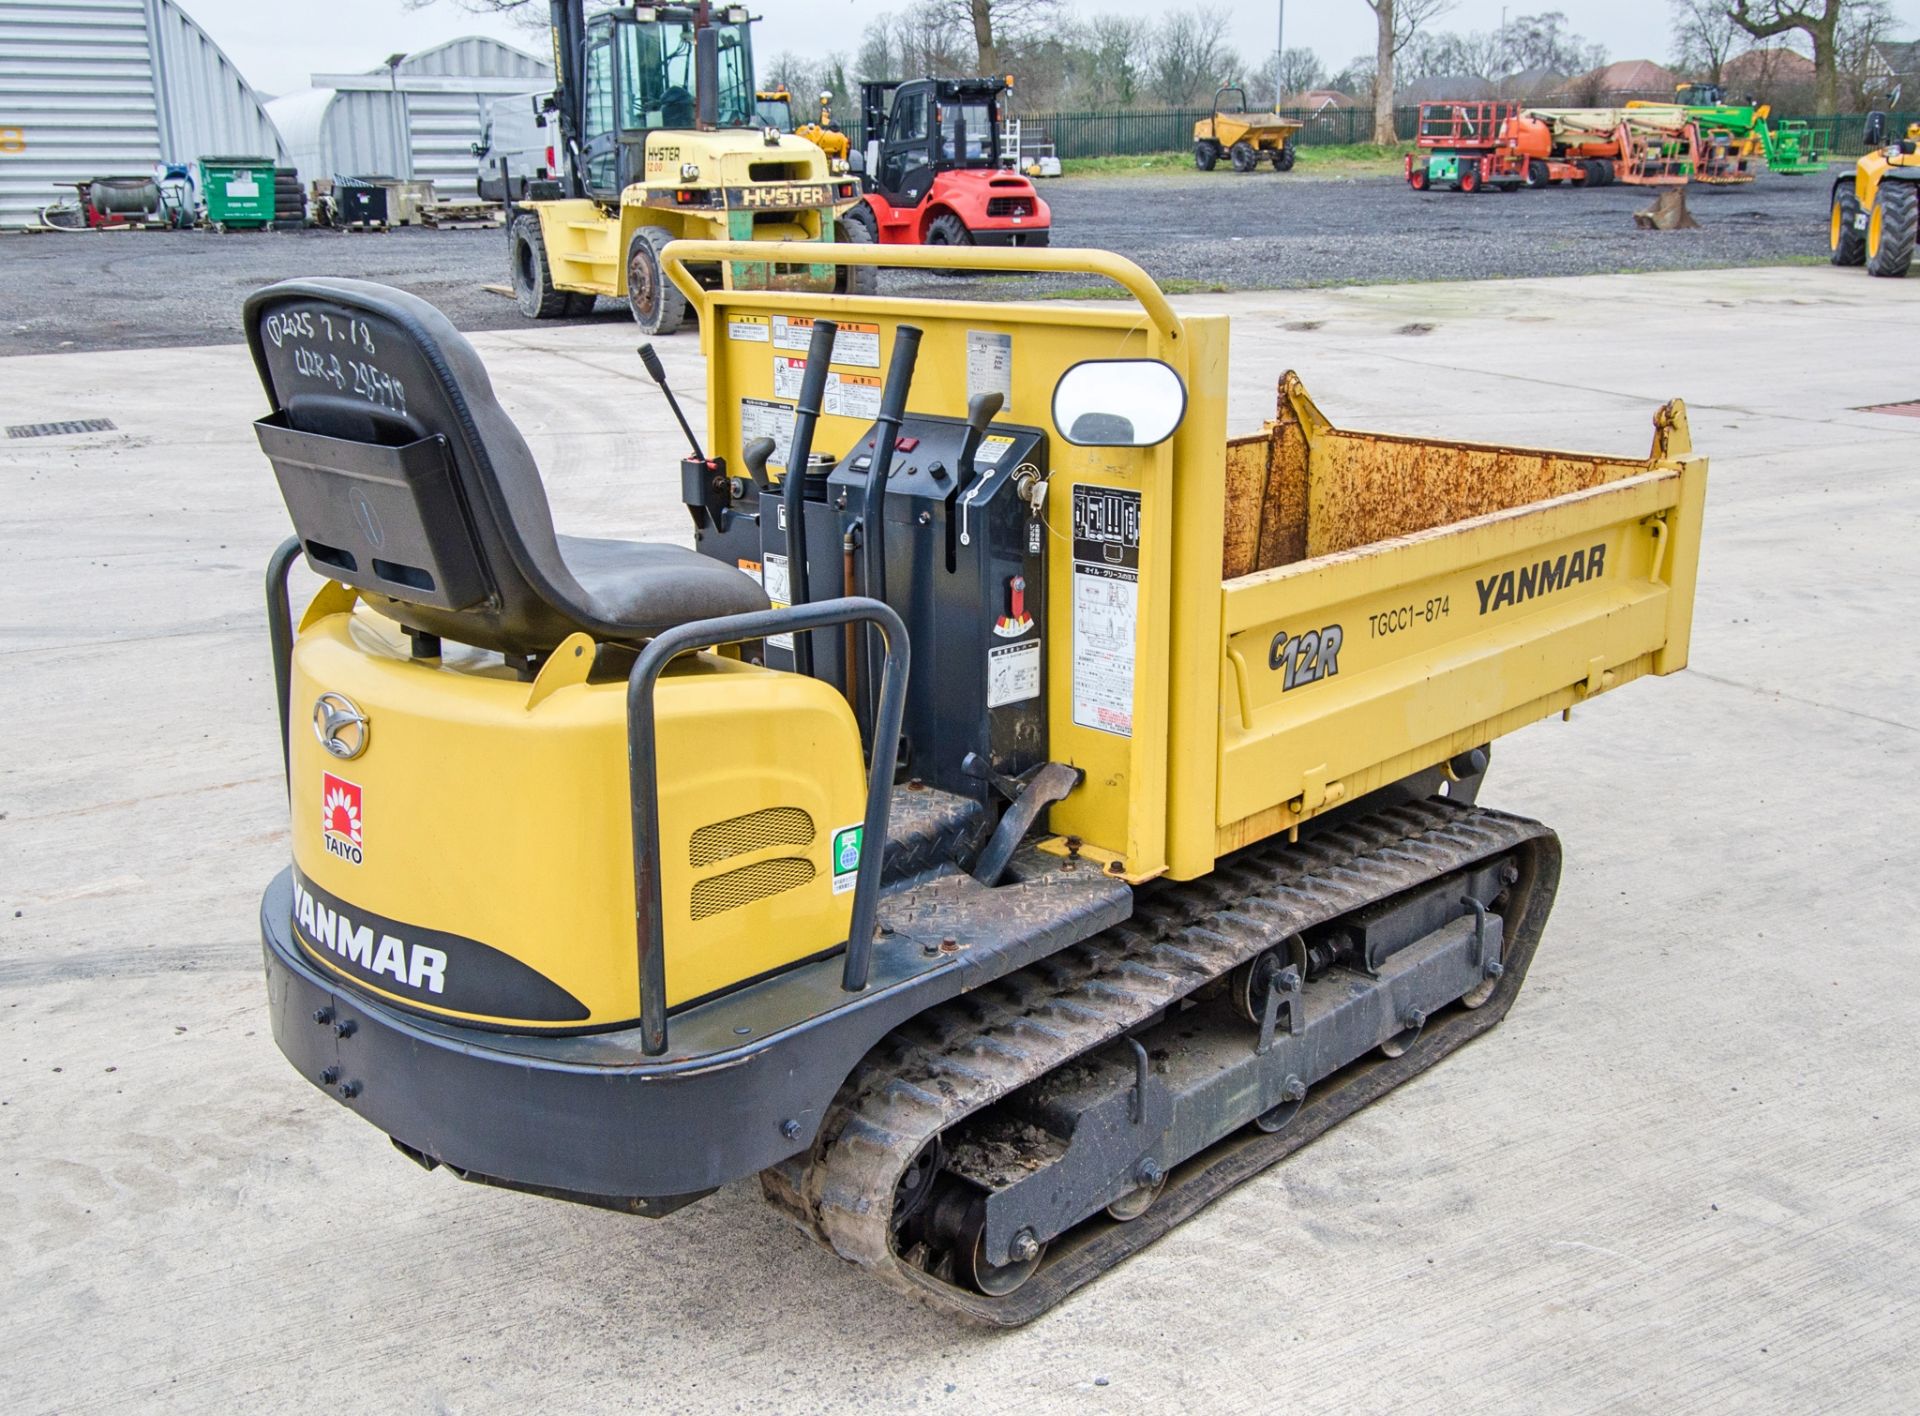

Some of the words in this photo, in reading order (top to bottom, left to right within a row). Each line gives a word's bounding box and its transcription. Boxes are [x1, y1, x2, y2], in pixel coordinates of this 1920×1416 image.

[648, 146, 680, 161] HYSTER
[743, 187, 823, 206] HYSTER
[1475, 543, 1606, 616] YANMAR
[1369, 595, 1450, 639] TGCC1-874
[324, 833, 362, 864] TAIYO
[293, 876, 448, 994] YANMAR
